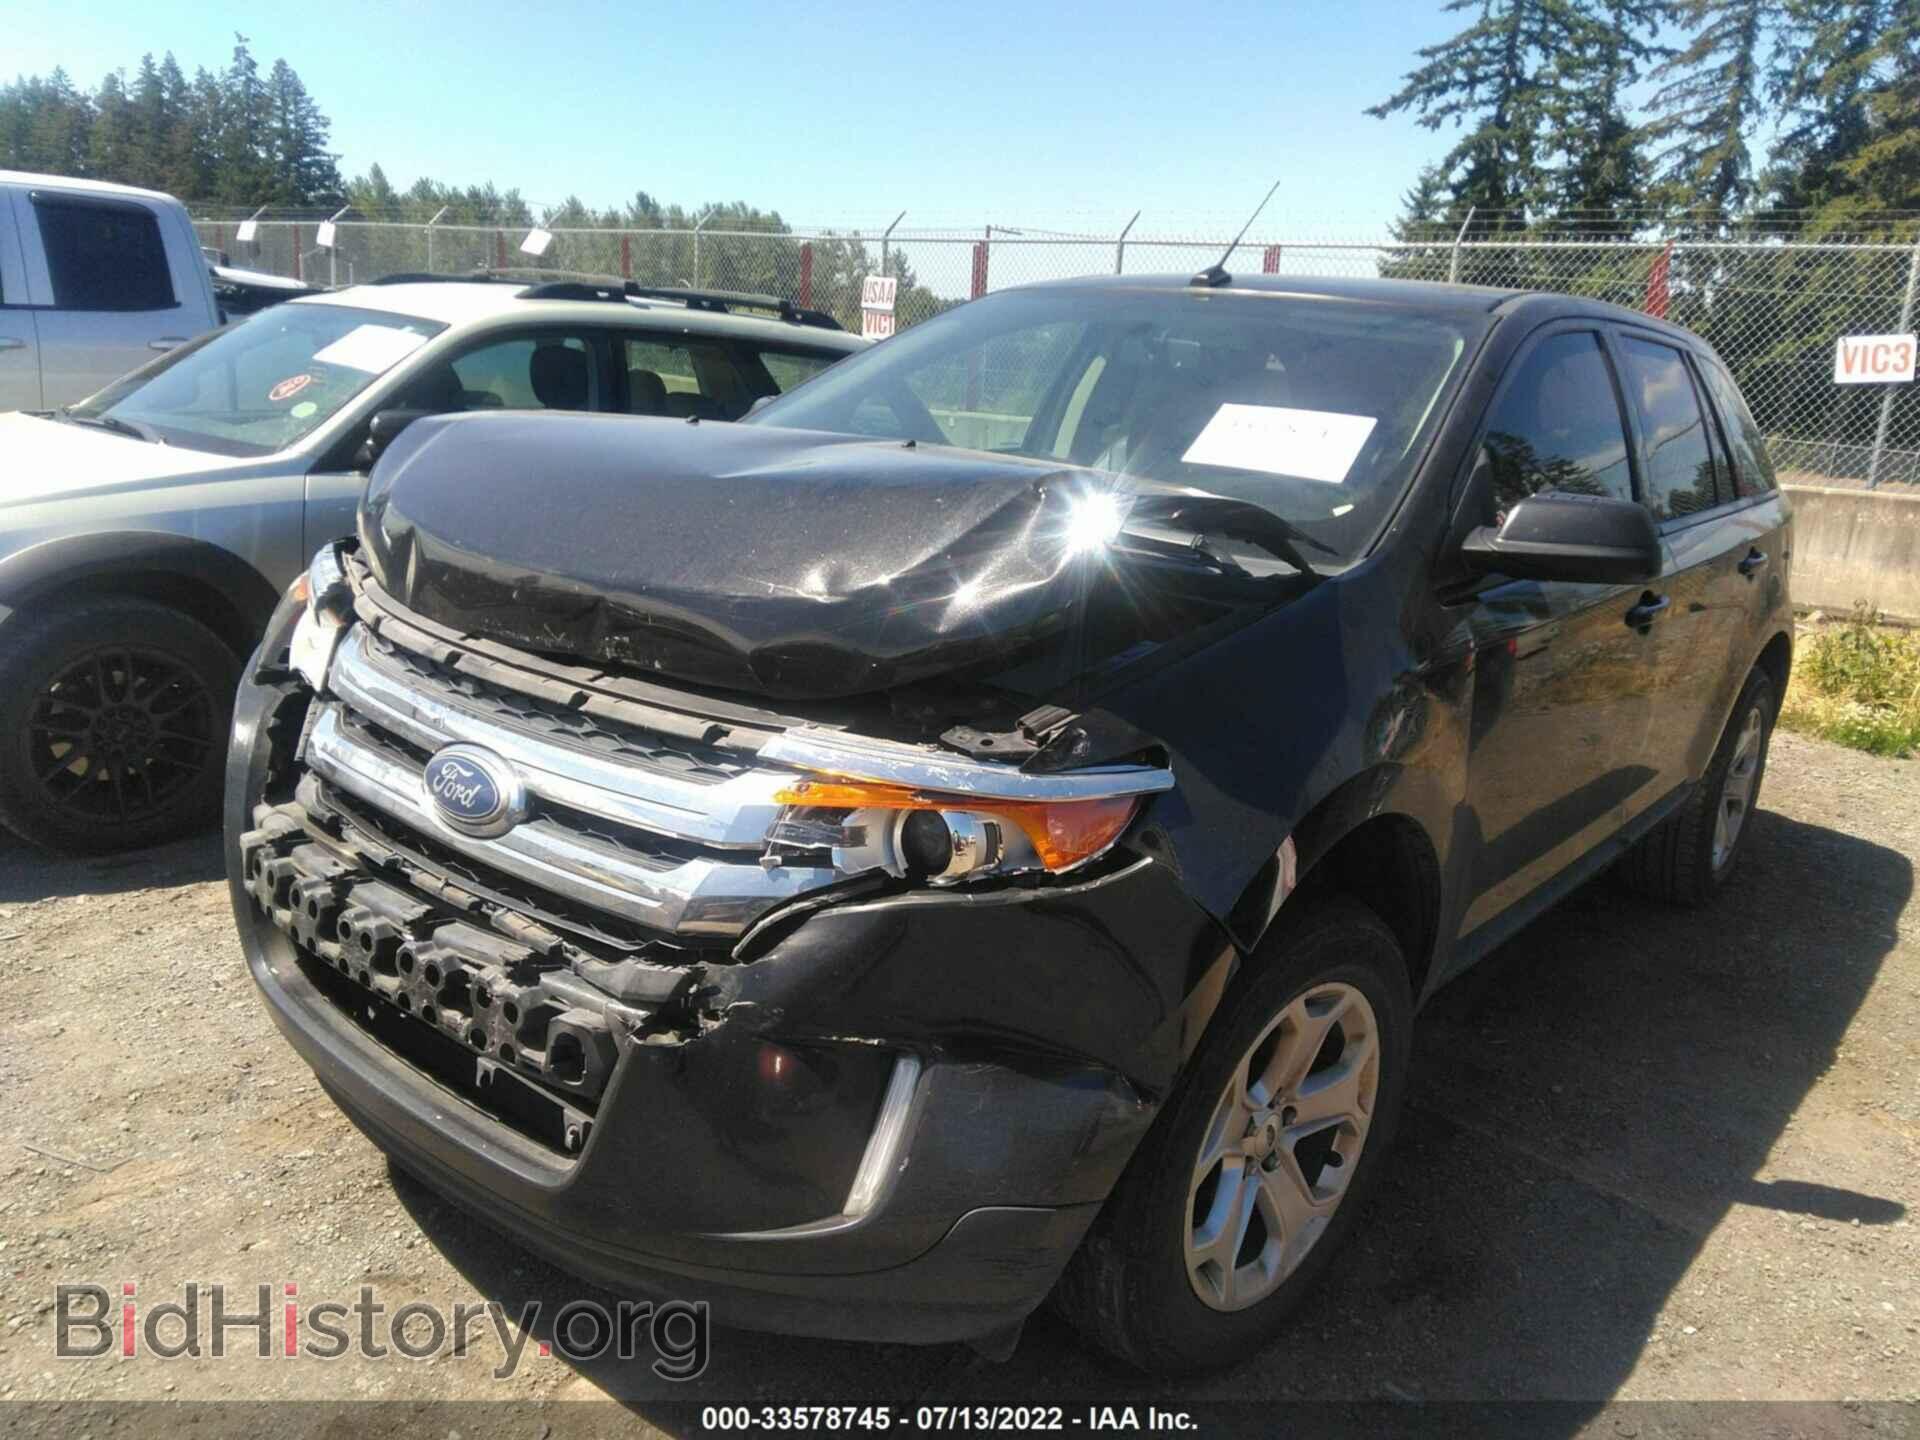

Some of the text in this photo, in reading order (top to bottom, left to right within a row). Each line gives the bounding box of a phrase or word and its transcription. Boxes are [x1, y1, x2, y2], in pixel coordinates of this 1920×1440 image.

[863, 280, 894, 304] USAA
[1842, 342, 1911, 375] VIC3
[433, 762, 482, 808] Ford
